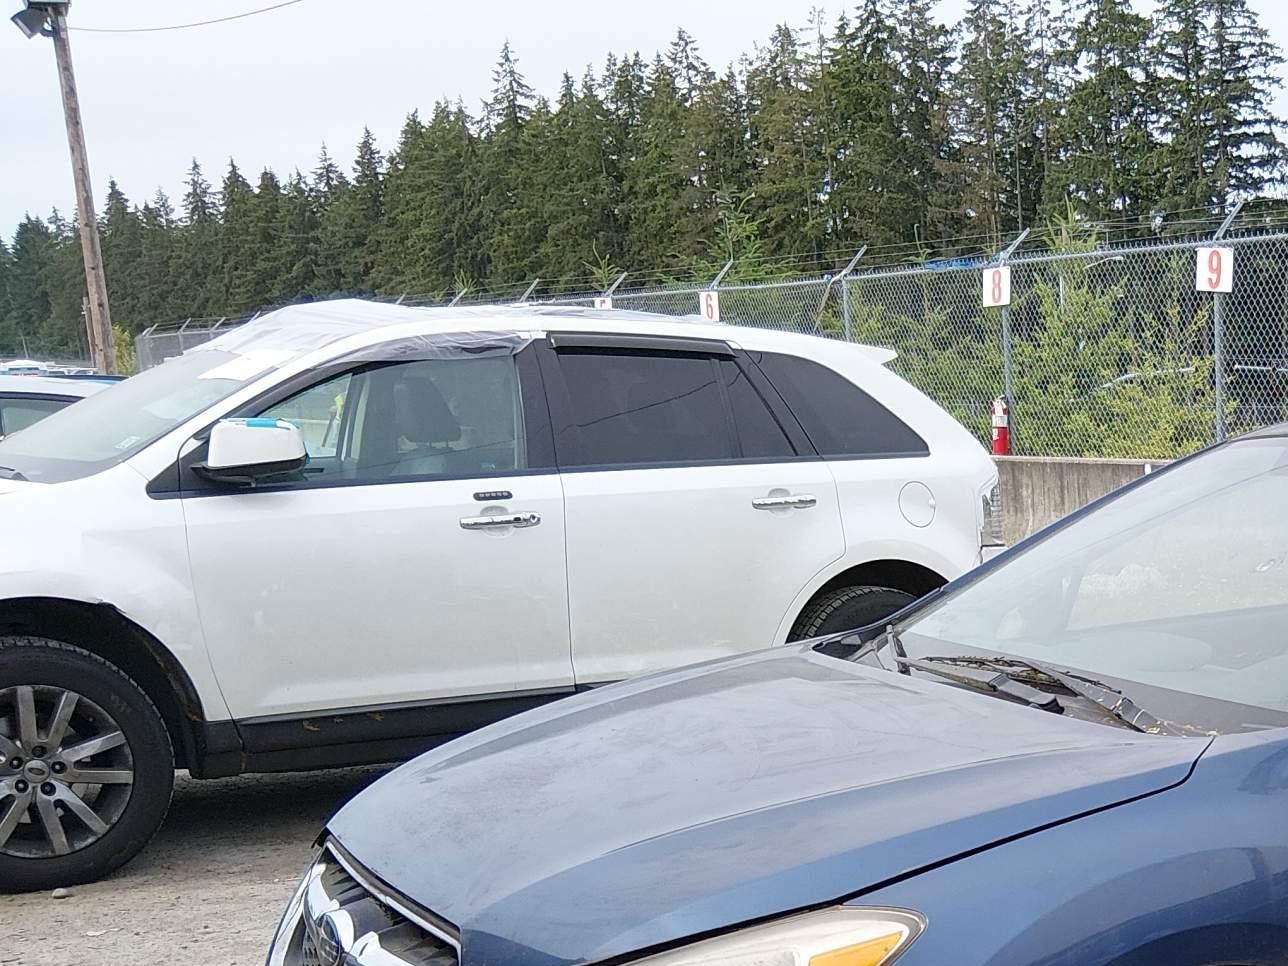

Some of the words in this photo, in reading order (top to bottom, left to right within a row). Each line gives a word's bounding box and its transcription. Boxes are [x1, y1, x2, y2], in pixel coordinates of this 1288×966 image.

[991, 269, 1002, 304] 8
[1207, 249, 1222, 290] 9
[705, 293, 714, 320] 6
